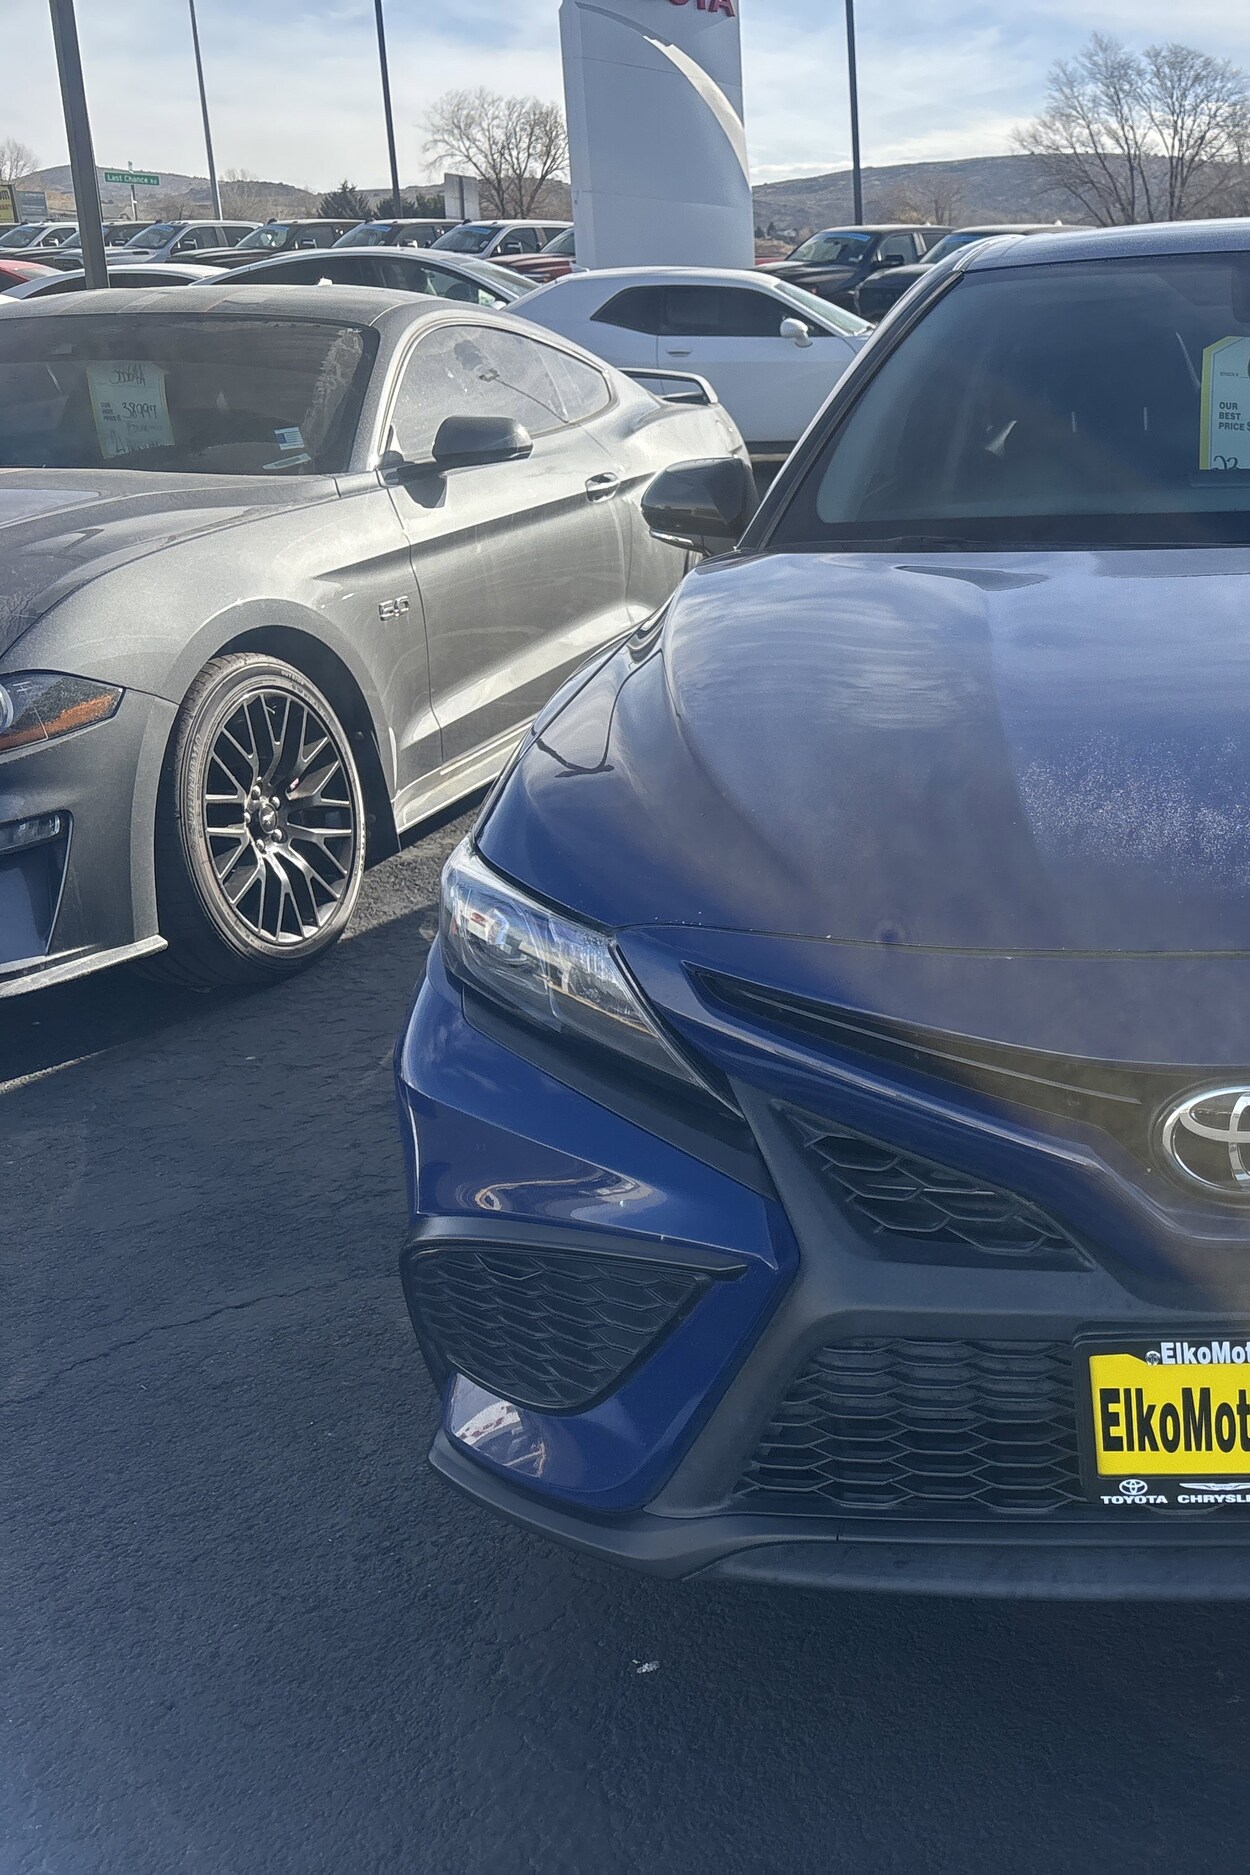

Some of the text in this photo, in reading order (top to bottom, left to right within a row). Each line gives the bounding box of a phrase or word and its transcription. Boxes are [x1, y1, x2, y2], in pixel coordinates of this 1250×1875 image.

[107, 174, 122, 182] Last
[124, 175, 149, 183] Chance
[1219, 401, 1238, 410] OUR
[1218, 411, 1241, 421] BEST
[1218, 421, 1245, 431] PRICE
[1100, 1495, 1168, 1504] TOYOTA
